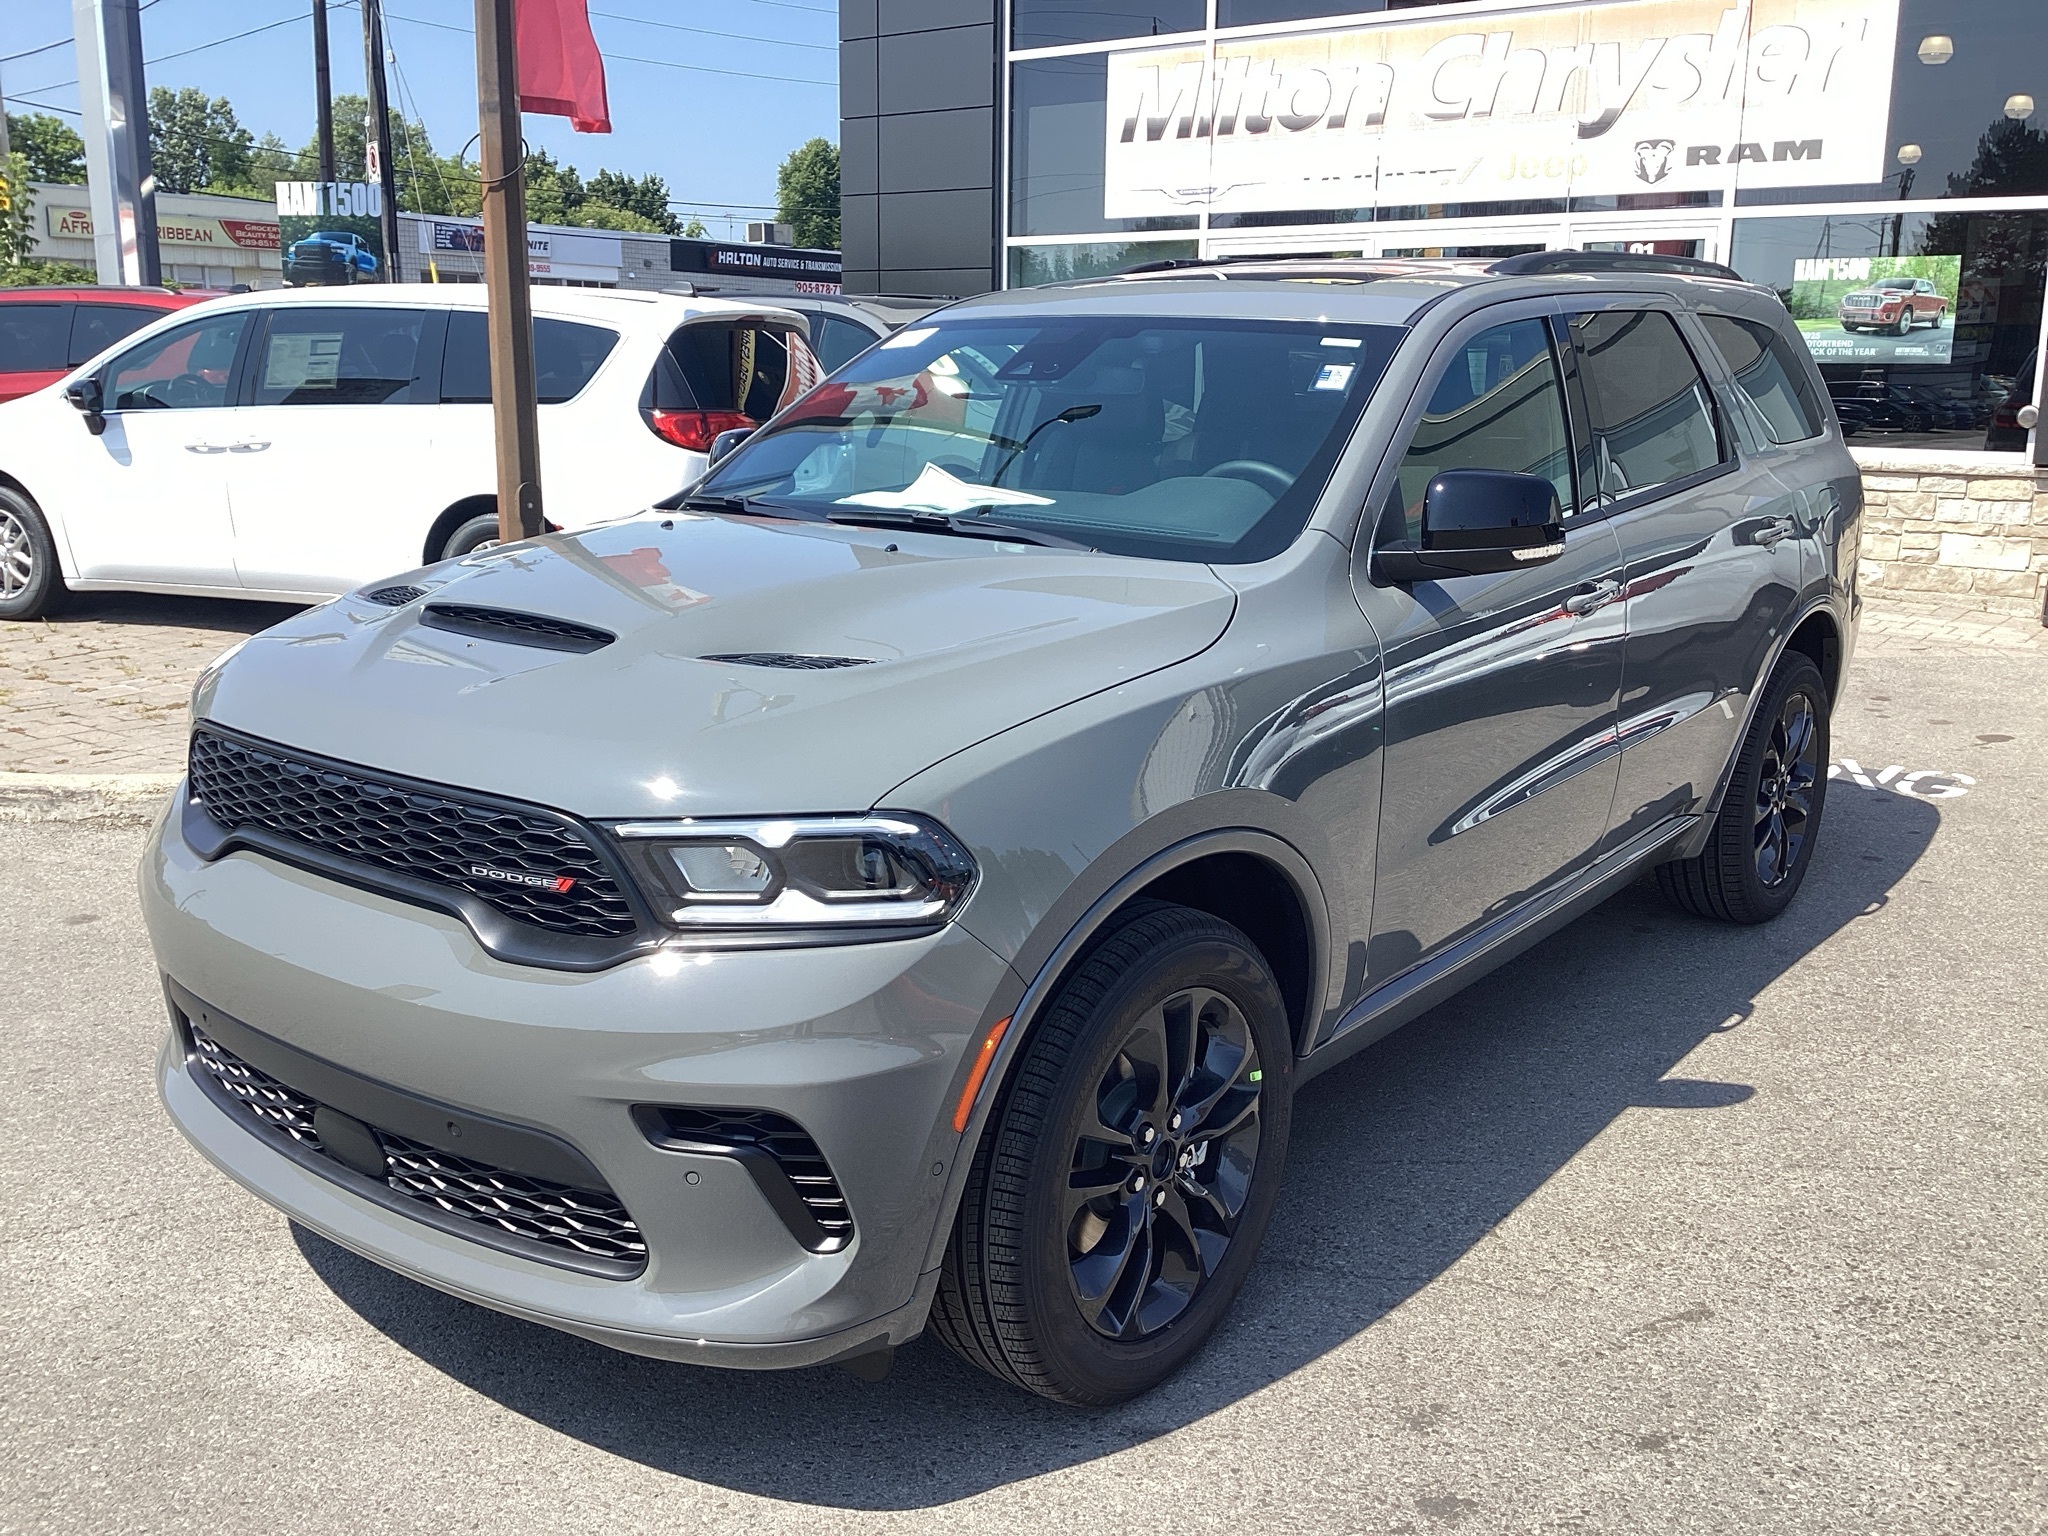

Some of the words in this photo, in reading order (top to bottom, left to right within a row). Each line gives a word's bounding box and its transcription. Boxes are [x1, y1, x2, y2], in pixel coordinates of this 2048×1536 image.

[1119, 55, 1395, 144] Milton
[1686, 138, 1824, 167] RAM
[1499, 150, 1589, 185] Jeep
[275, 181, 324, 216] RAM
[328, 182, 382, 218] 1500
[59, 217, 94, 234] AFRI
[156, 226, 213, 242] RIBBEAN
[240, 238, 281, 248] 289-851-3
[528, 239, 549, 251] NITE
[718, 250, 761, 267] HALTON
[762, 256, 777, 268] AUTO
[777, 257, 800, 270] SERVICE
[796, 282, 842, 295] 905-878-7
[1806, 339, 1854, 348] OTORTREND
[1826, 347, 1837, 356] OF
[1838, 347, 1854, 356] THE
[1854, 347, 1876, 356] YEAR
[471, 866, 560, 889] DODGE
